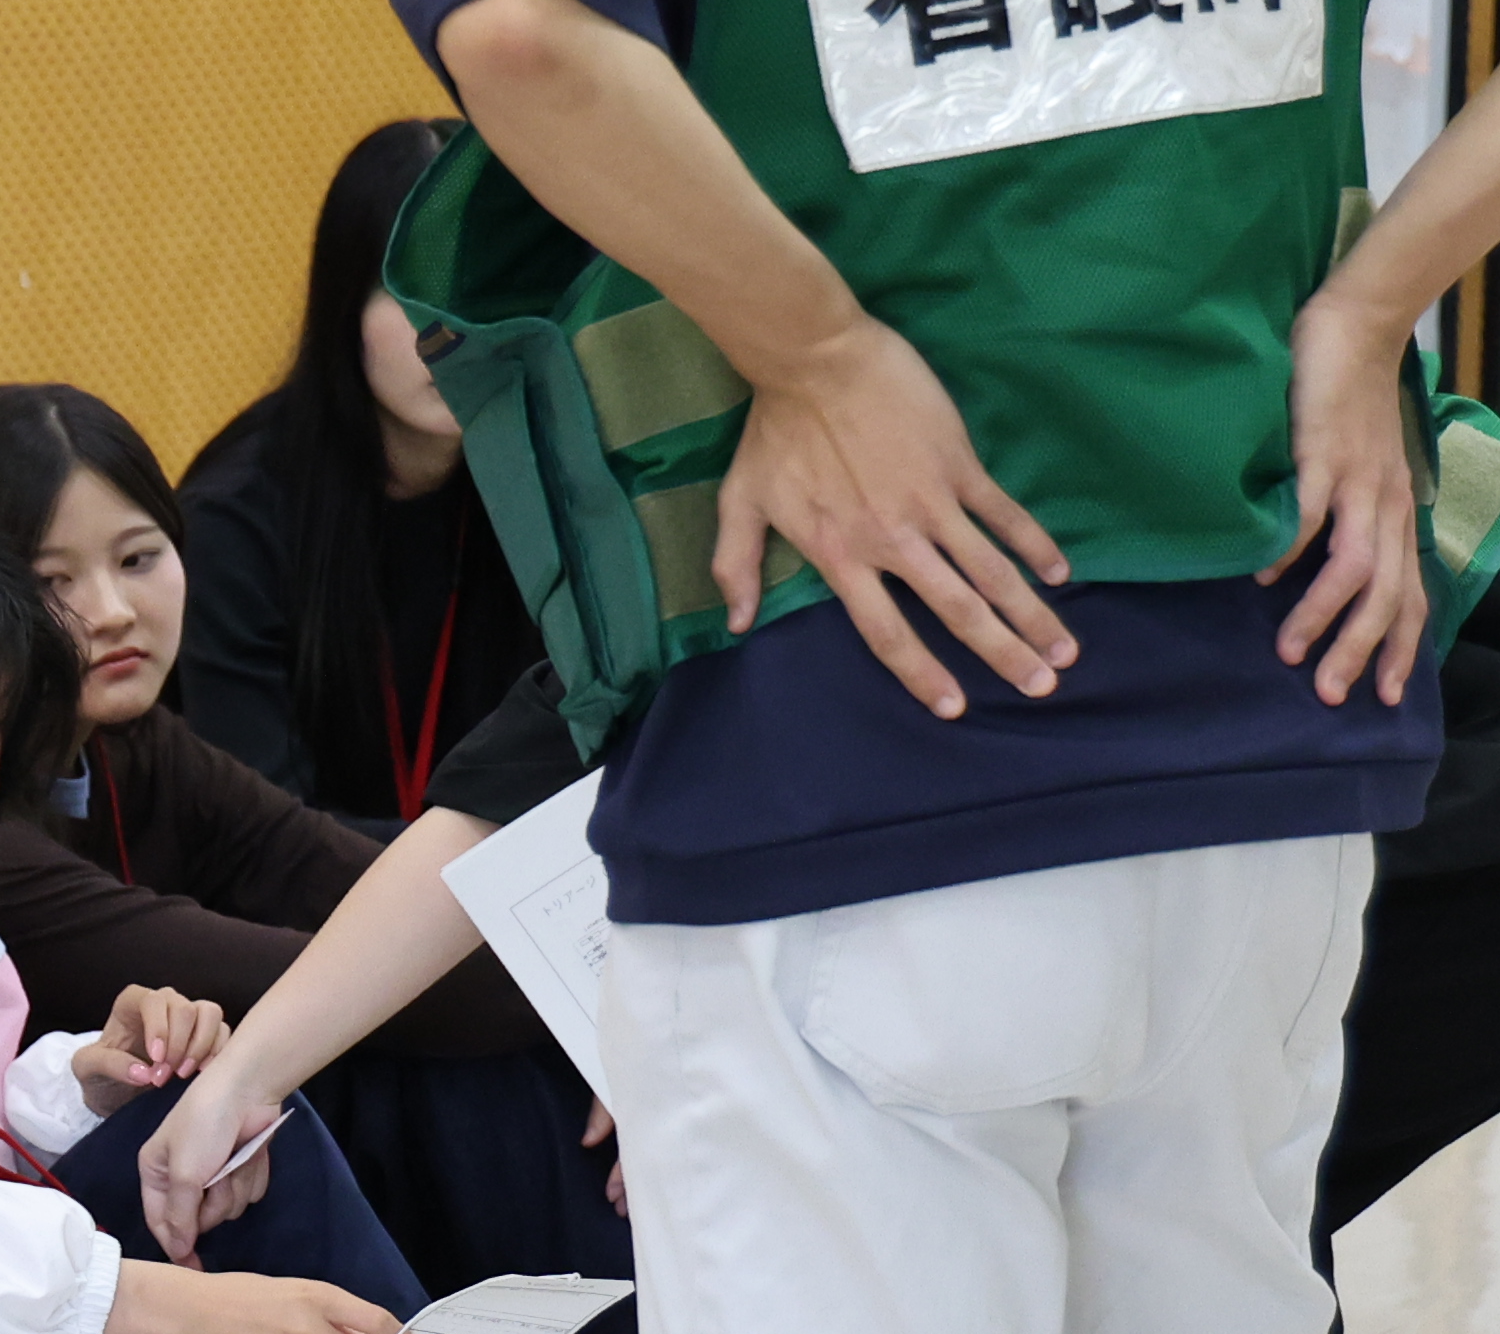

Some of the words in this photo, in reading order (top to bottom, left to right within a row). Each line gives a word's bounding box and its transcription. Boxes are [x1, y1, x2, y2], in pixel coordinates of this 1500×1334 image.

[542, 866, 609, 917] トリアージ
